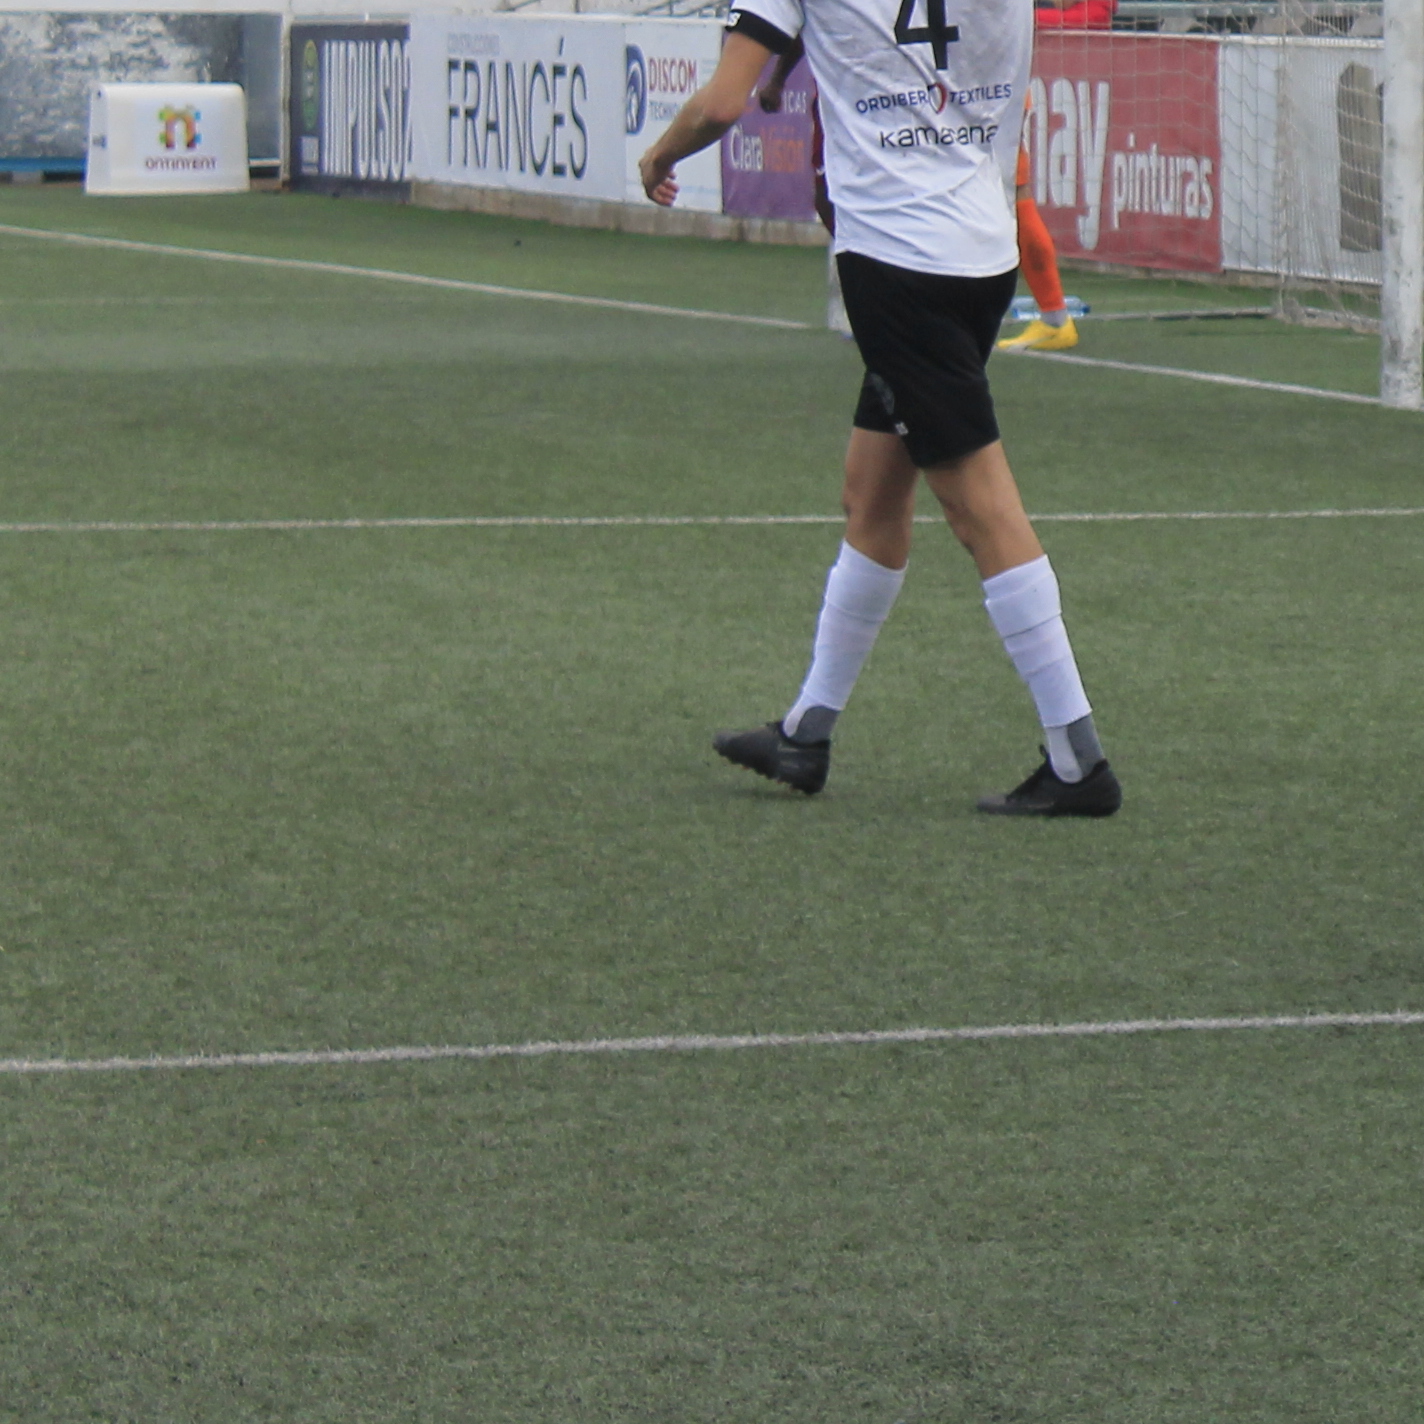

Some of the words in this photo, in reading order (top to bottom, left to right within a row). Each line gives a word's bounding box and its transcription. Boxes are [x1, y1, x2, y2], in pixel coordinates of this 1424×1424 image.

[448, 36, 588, 179] FRANCÉS
[856, 90, 928, 114] ORDIBER
[950, 84, 1012, 105] TEXTILES
[730, 125, 764, 172] Clara
[1111, 133, 1214, 233] pinturas
